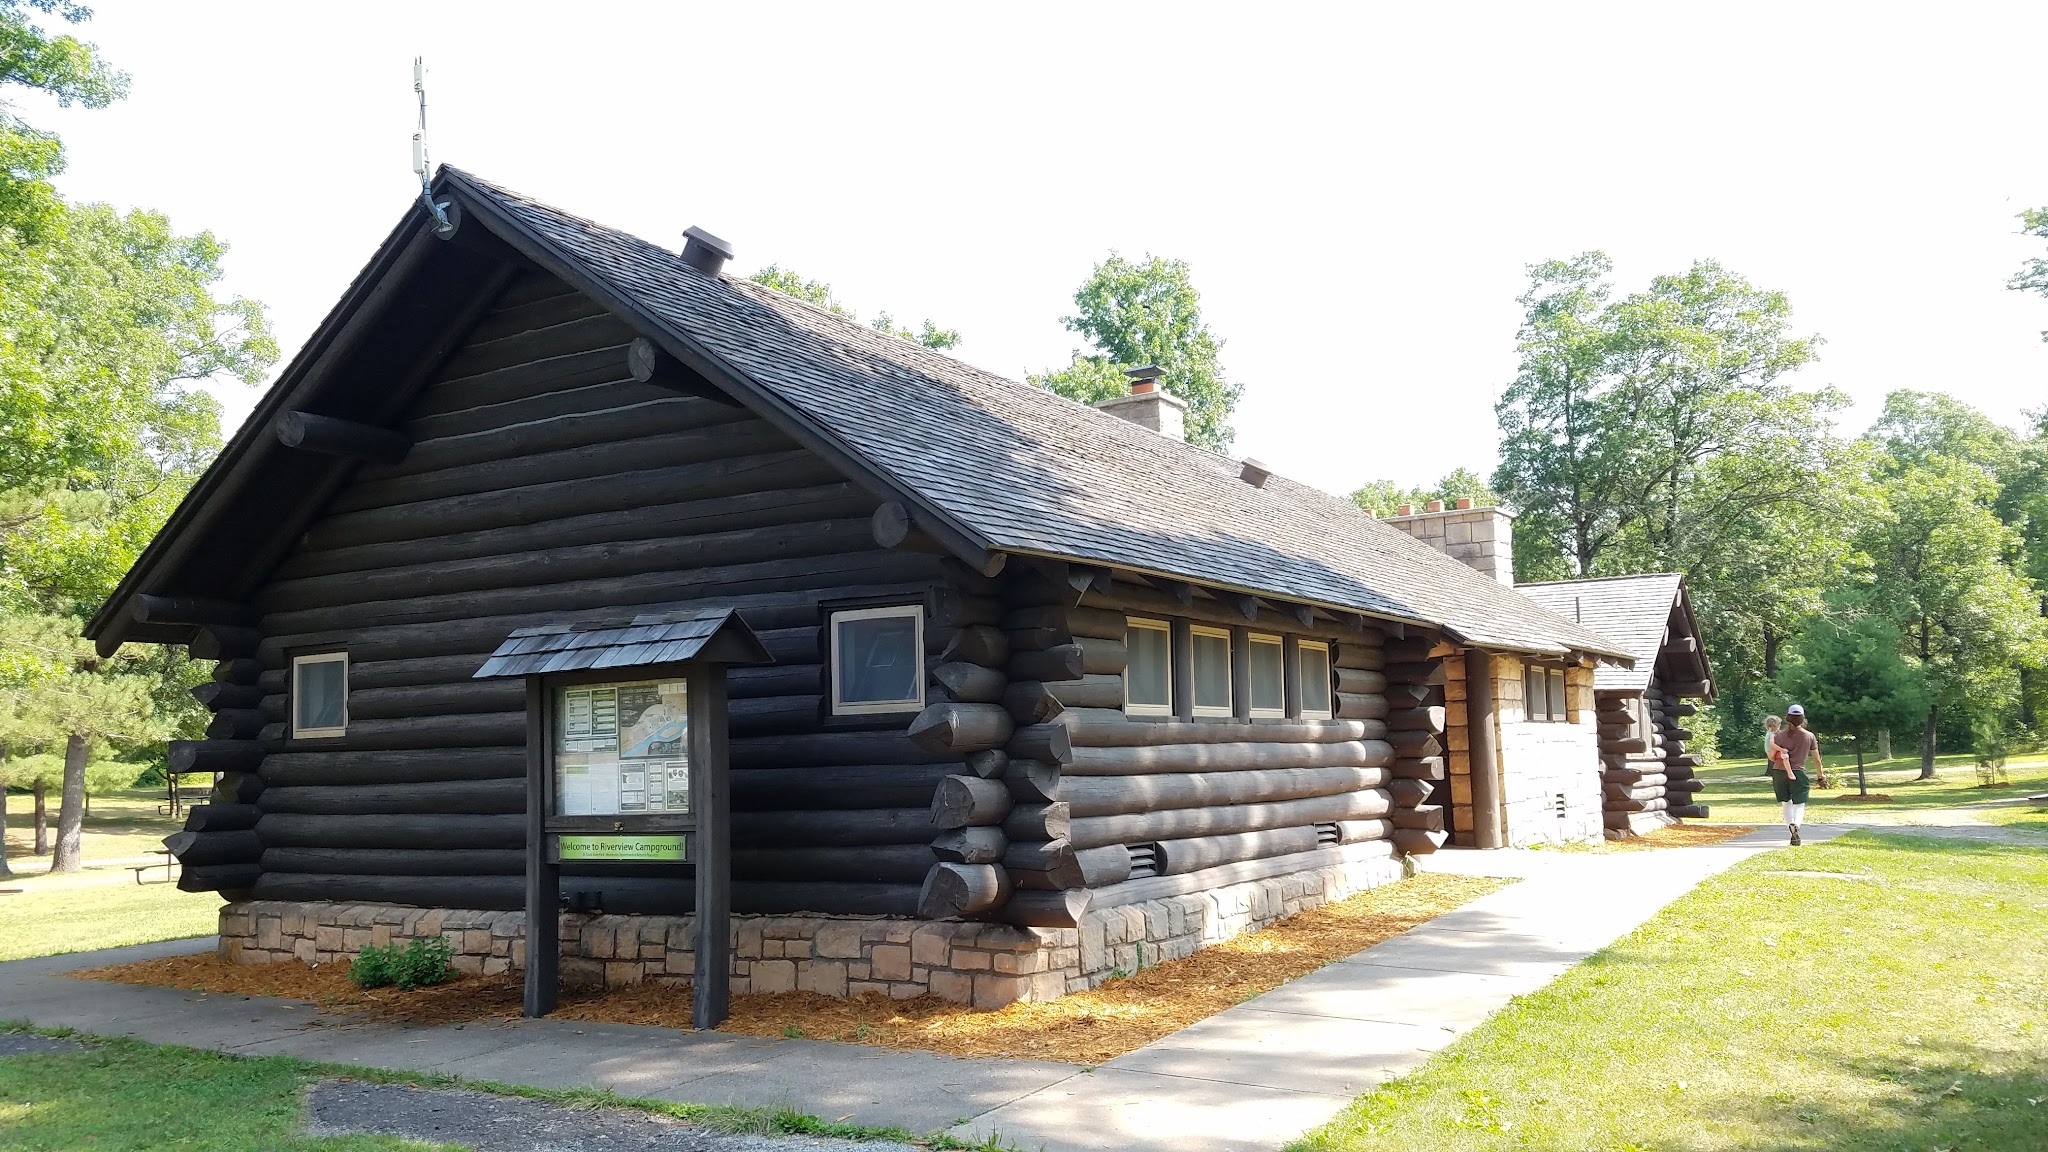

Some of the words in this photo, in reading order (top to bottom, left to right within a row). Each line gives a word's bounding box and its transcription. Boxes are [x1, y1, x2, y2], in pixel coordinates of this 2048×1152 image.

[560, 842, 591, 851] Welcome
[592, 843, 599, 851] to
[600, 842, 634, 851] Riverview
[635, 842, 684, 853] Campground!
